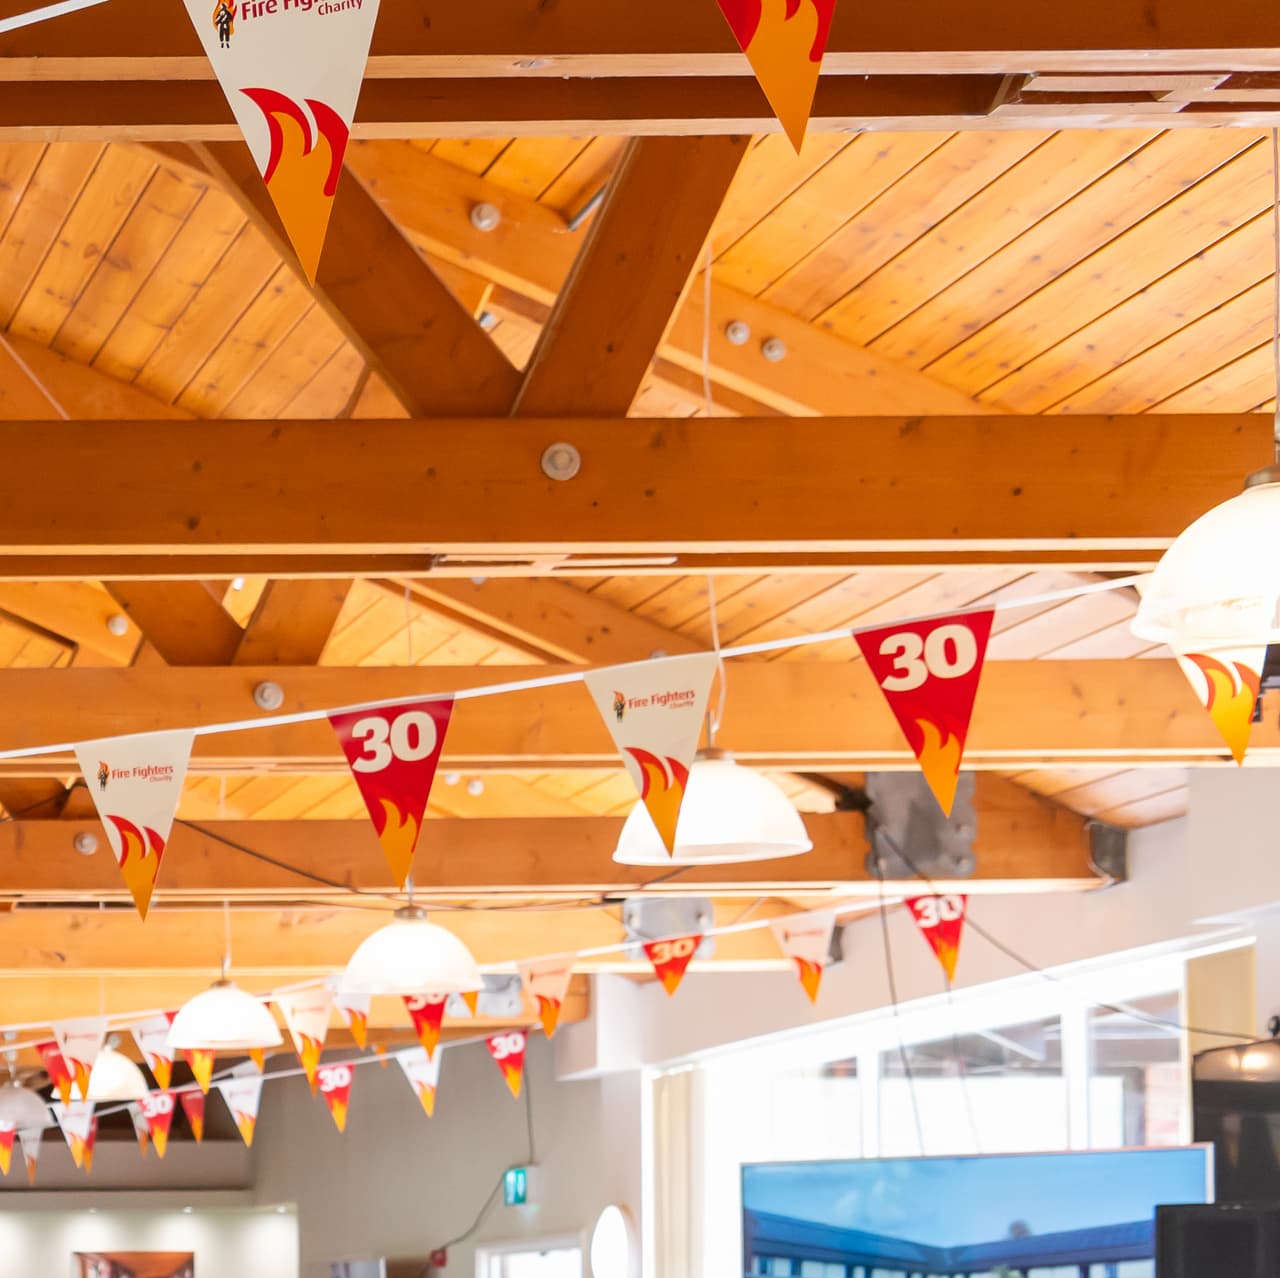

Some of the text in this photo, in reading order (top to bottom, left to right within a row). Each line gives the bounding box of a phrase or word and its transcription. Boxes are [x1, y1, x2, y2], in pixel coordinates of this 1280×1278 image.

[879, 623, 978, 692] 30
[351, 711, 437, 773] 30
[111, 764, 173, 780] Fire Fighters
[914, 895, 963, 928] 30
[650, 940, 695, 965] 30
[491, 1033, 524, 1059] 30
[318, 1067, 351, 1092] 30
[142, 1094, 173, 1118] 30
